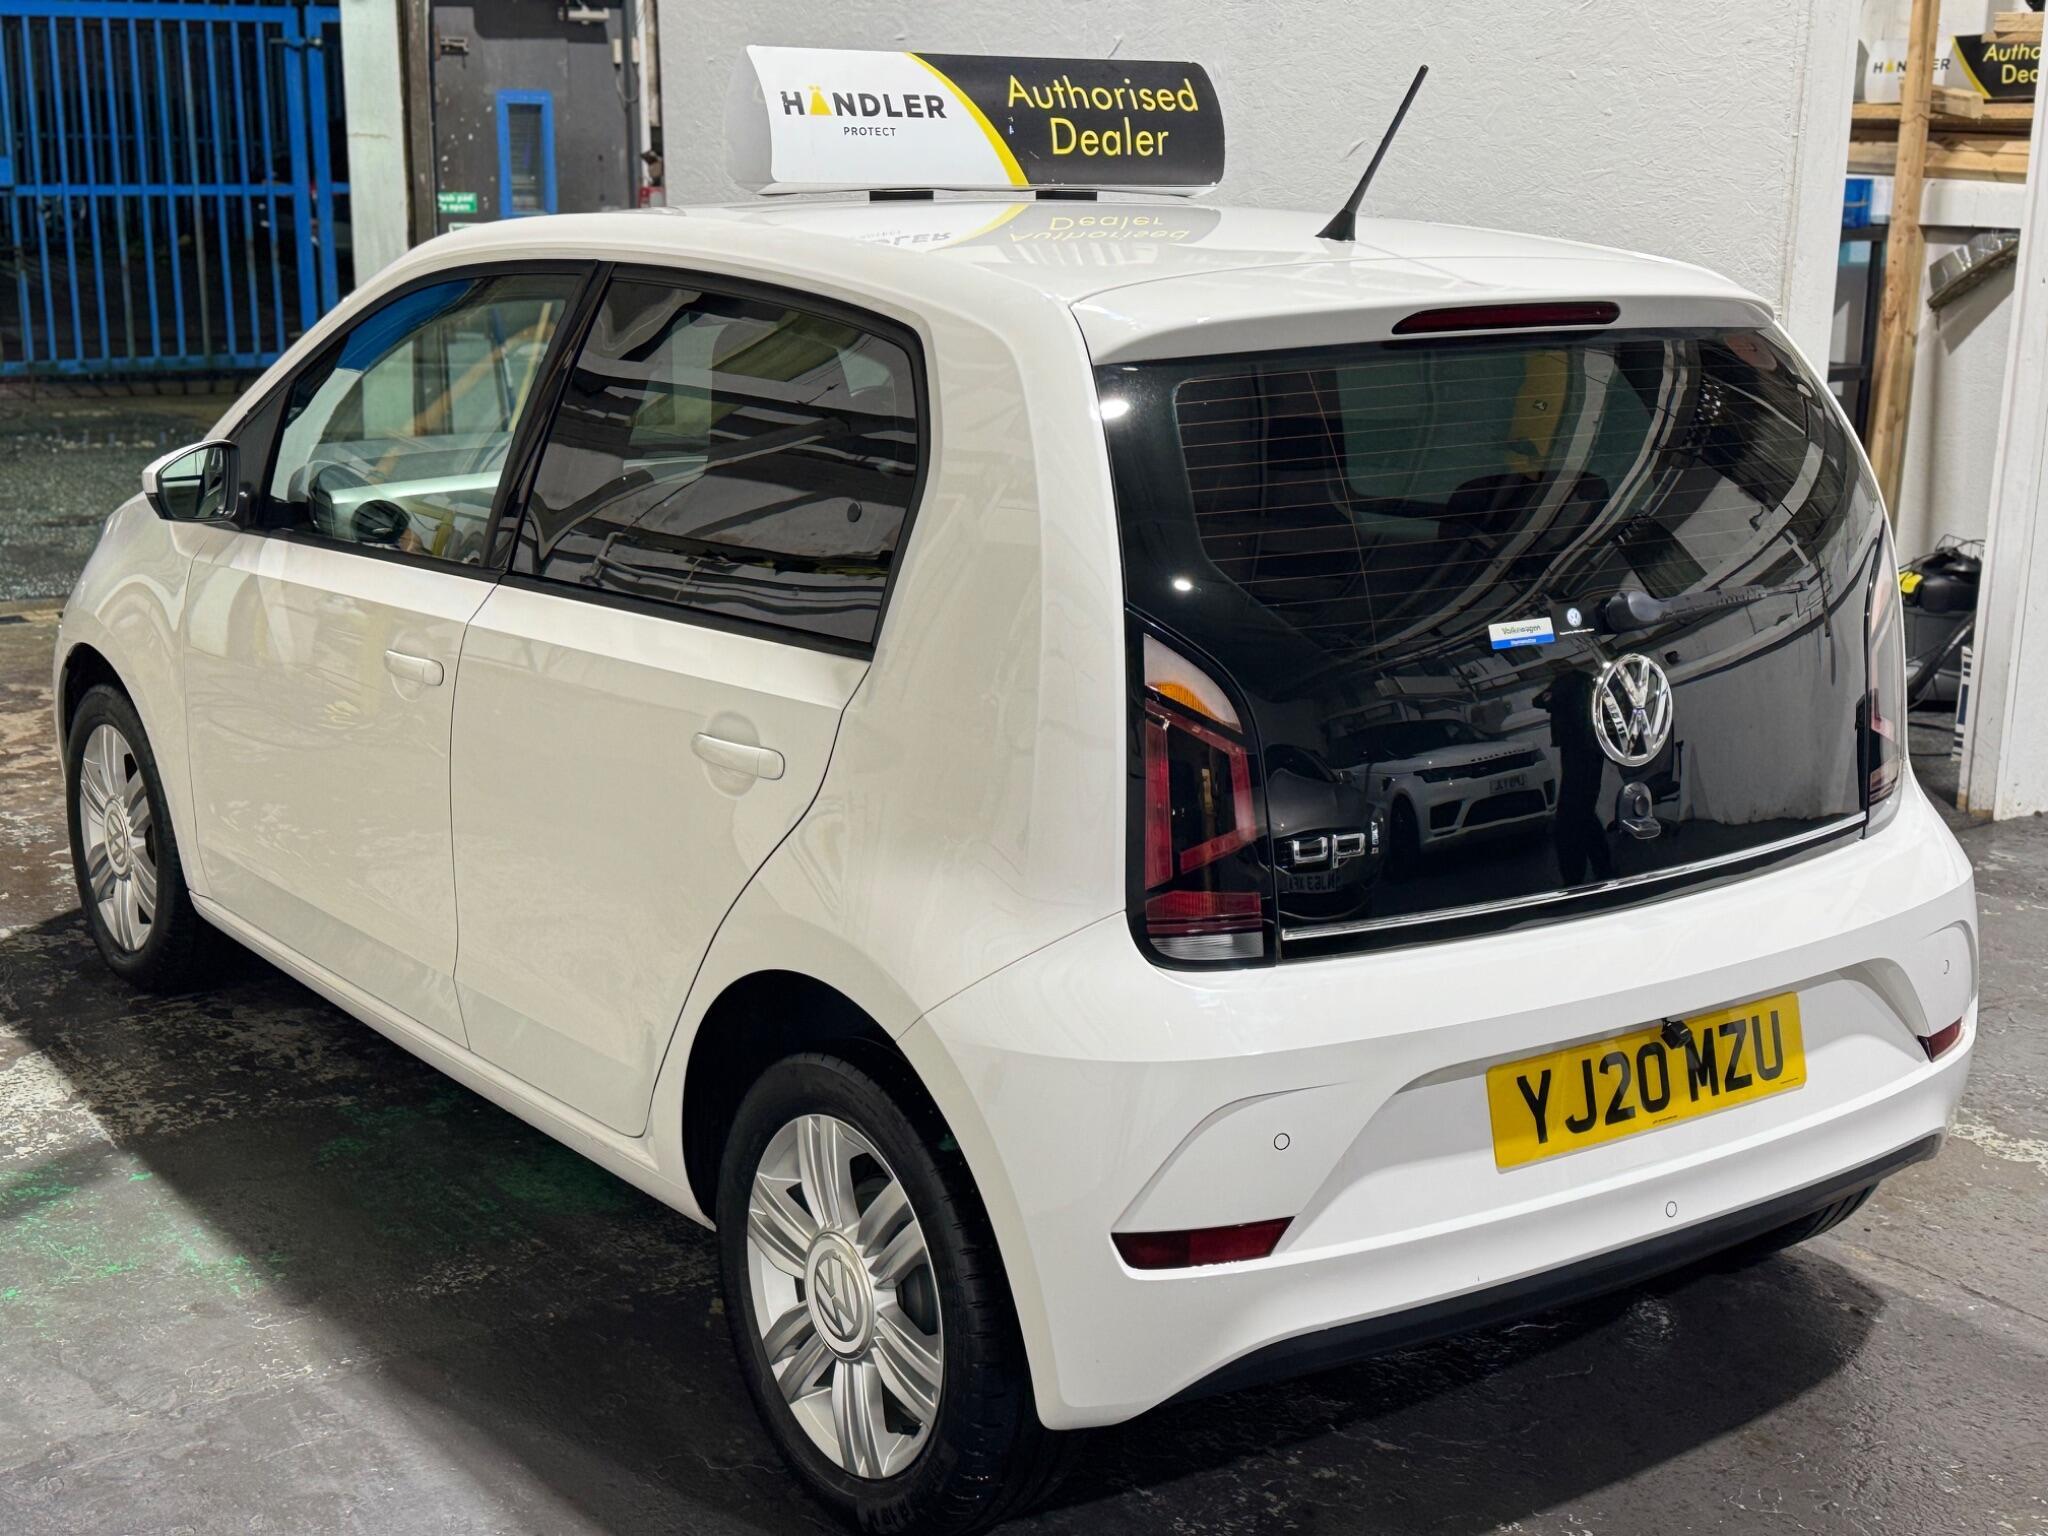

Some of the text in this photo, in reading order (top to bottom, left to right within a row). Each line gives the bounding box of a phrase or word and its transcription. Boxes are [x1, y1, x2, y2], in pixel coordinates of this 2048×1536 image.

[1008, 74, 1199, 112] Authorised
[843, 126, 897, 137] PROTECT
[1050, 116, 1169, 156] Dealer
[1516, 1010, 1785, 1145] YJ20 MZU
